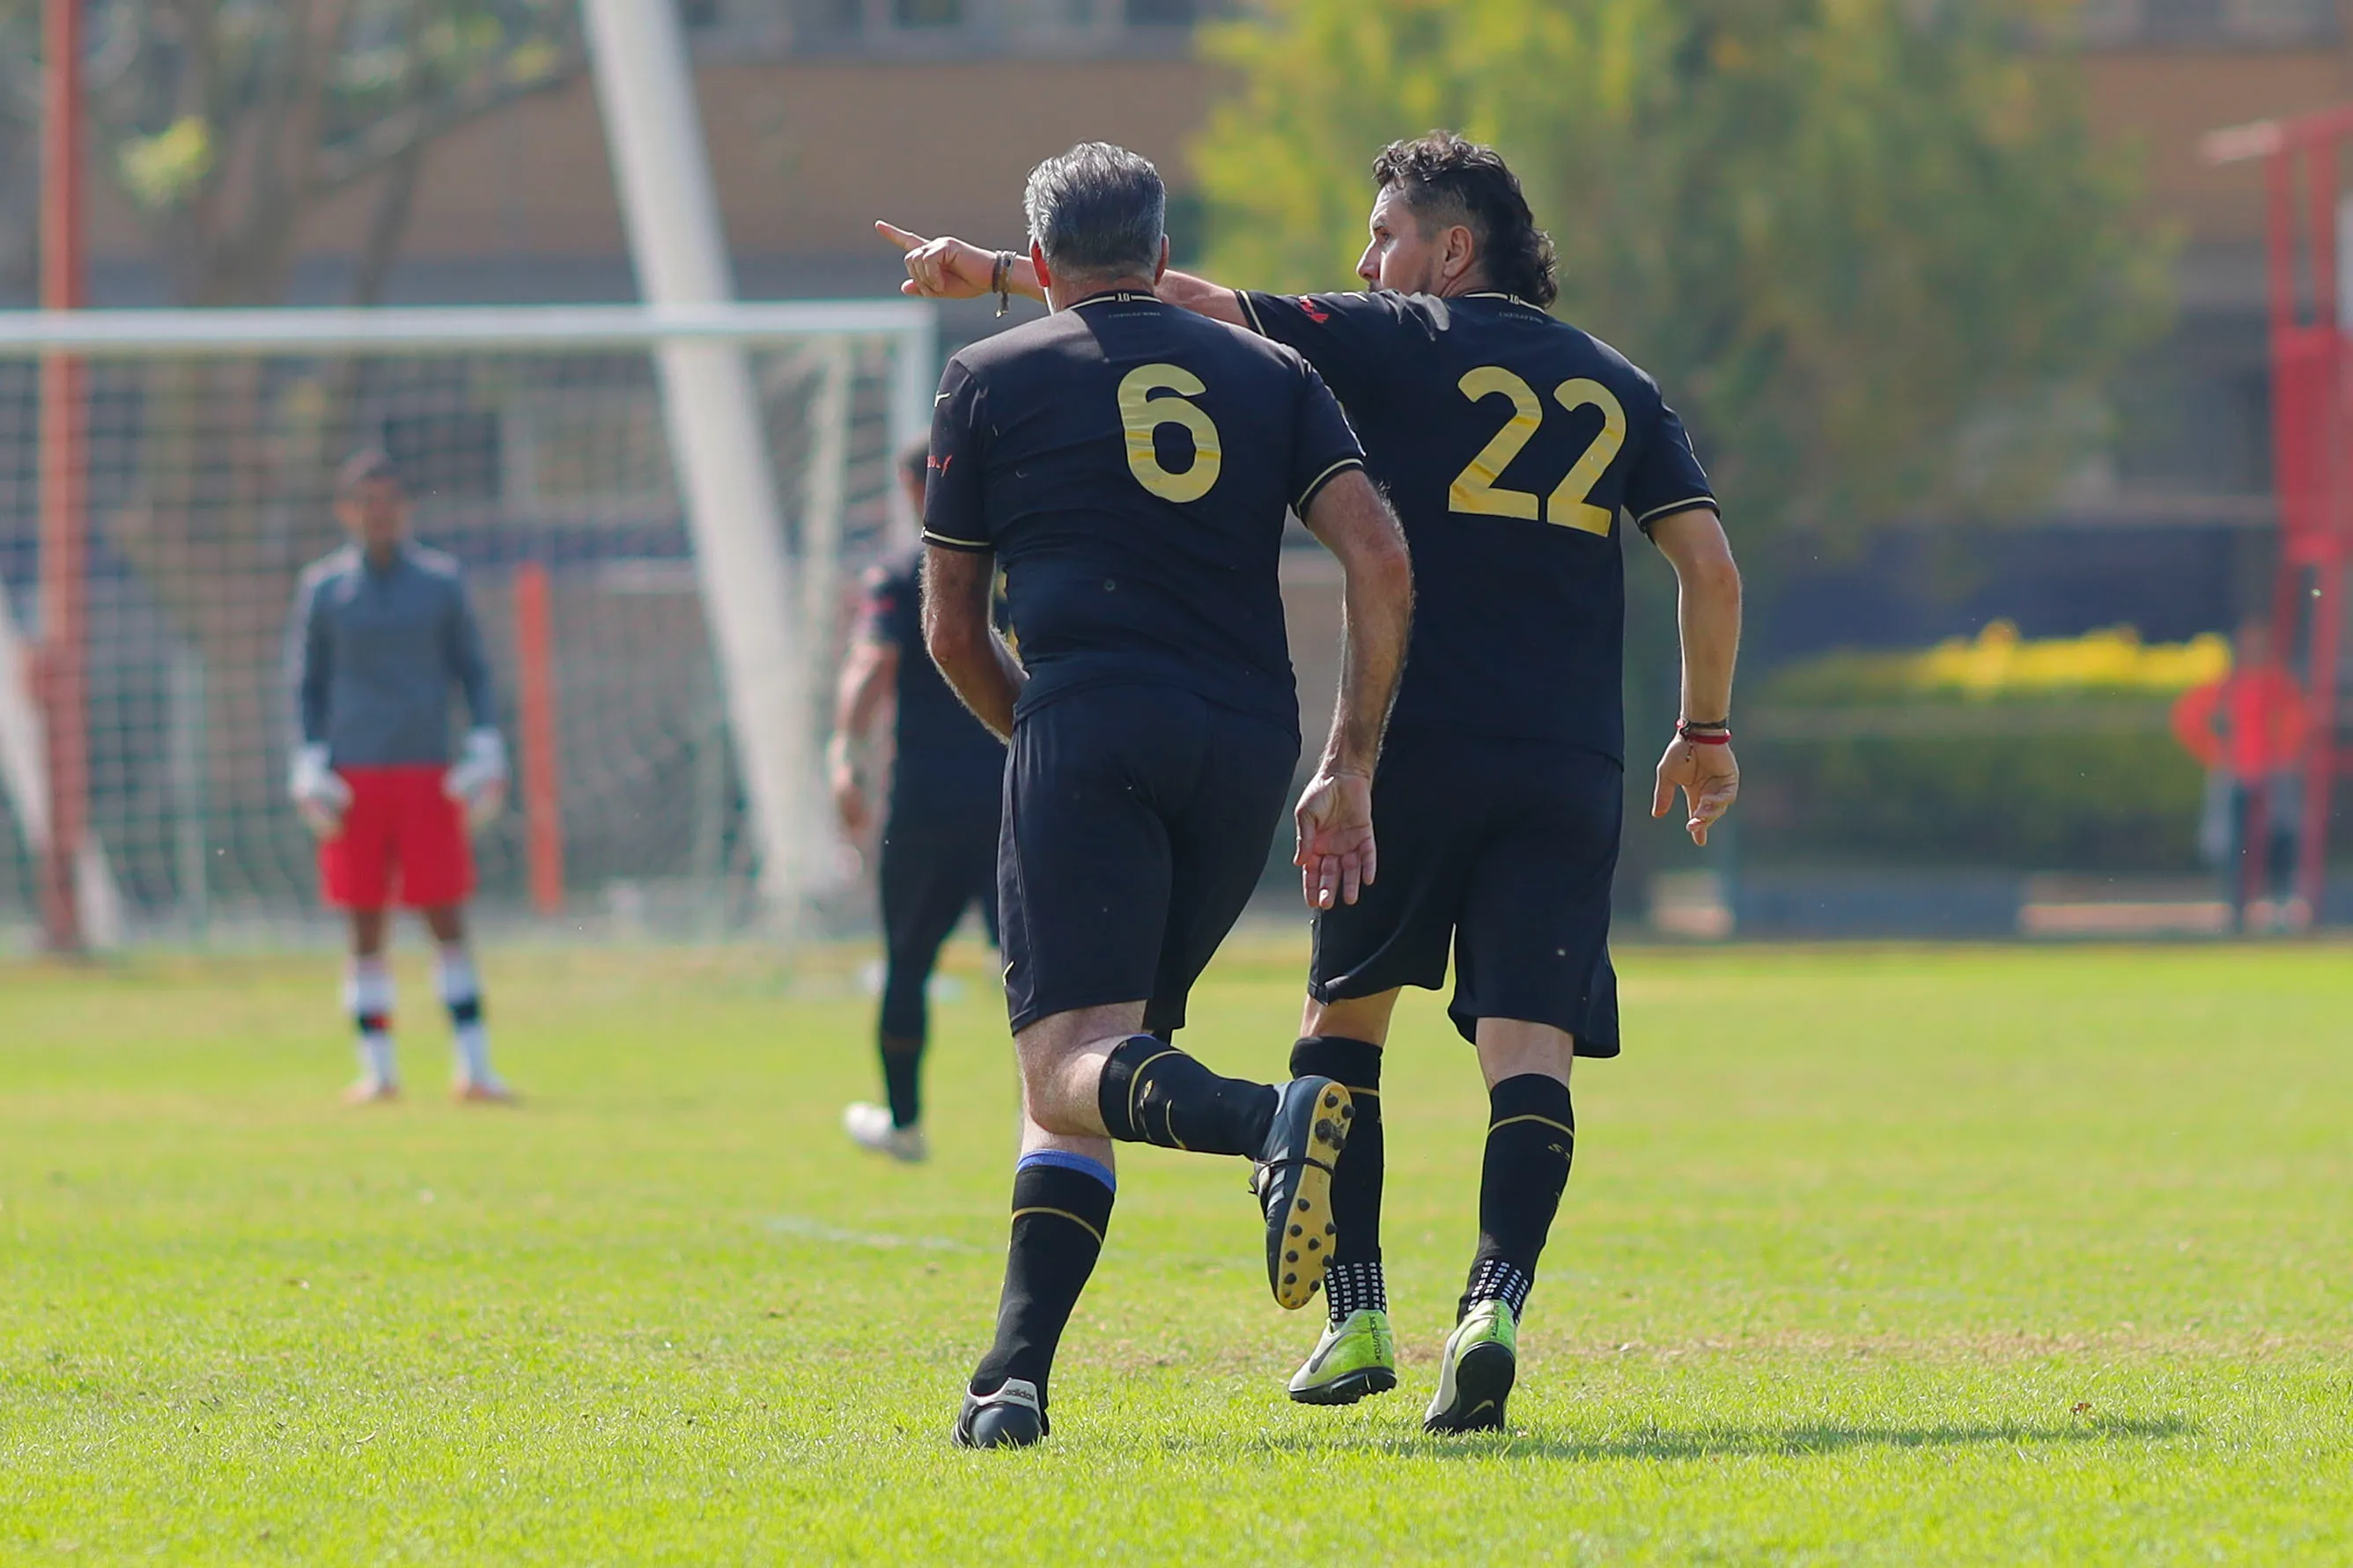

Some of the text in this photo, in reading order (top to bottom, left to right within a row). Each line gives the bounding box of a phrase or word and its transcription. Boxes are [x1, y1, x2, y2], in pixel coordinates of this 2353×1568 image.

[1117, 363, 1222, 504] 6
[1448, 365, 1626, 538] 22
[1005, 1388, 1036, 1402] adidas
